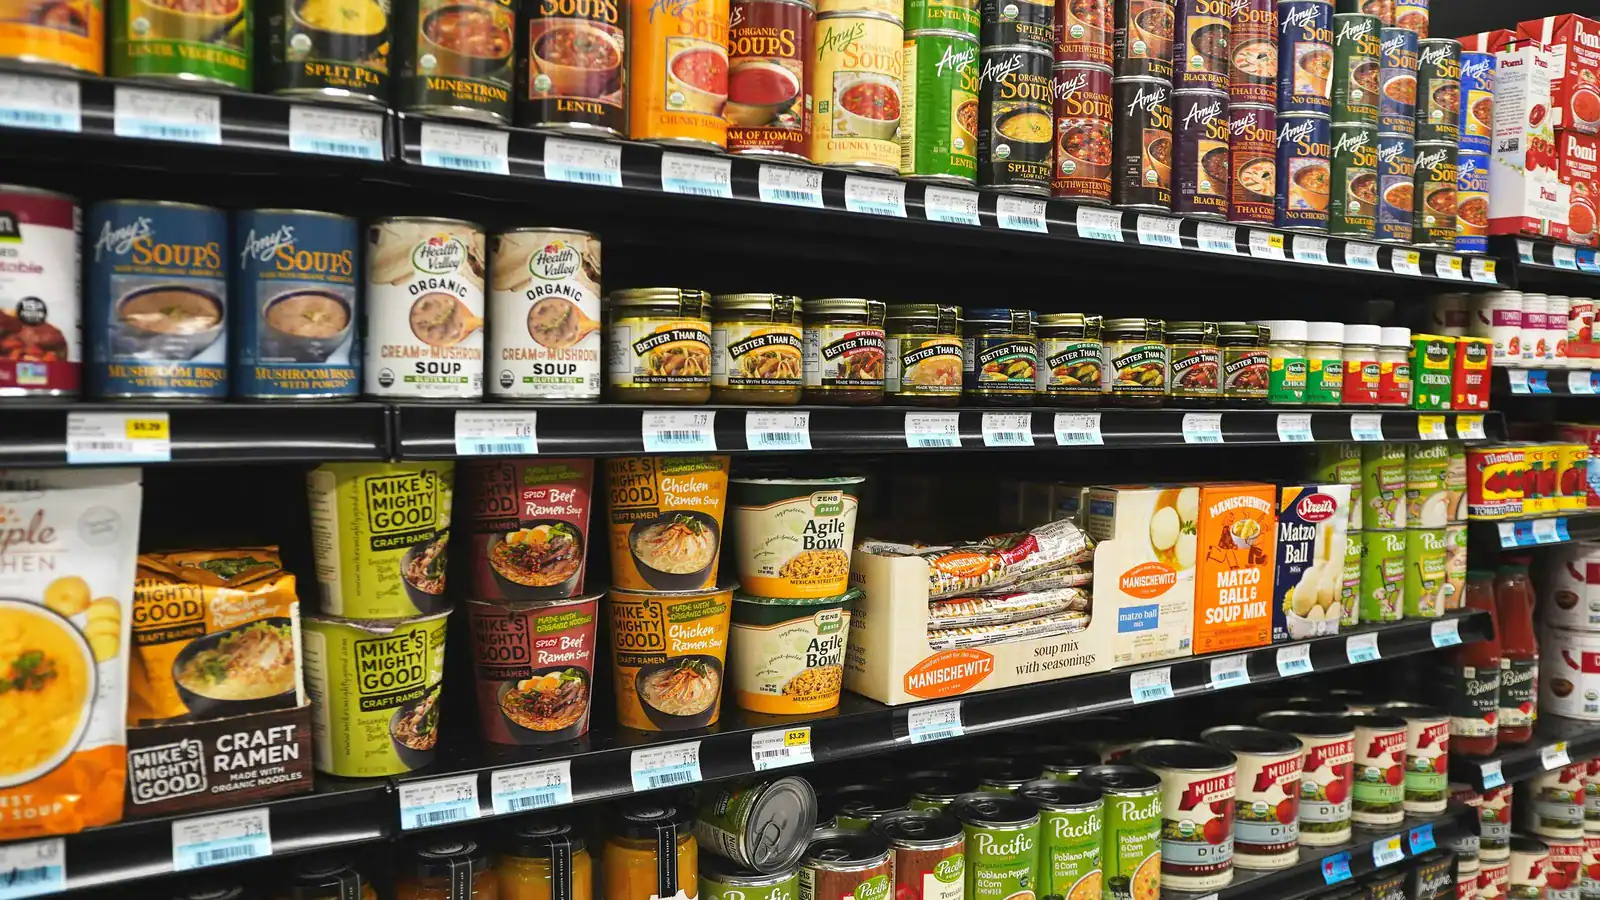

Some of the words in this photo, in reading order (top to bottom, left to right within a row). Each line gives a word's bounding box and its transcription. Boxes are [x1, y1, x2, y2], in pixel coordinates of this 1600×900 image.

[738, 28, 778, 37] ORGANIC
[1016, 23, 1042, 38] SPLIT
[935, 45, 976, 78] Amy's
[1418, 44, 1452, 69] Amy's
[1500, 59, 1524, 70] Pomi
[1534, 56, 1549, 68] Pomi
[305, 63, 350, 80] SPLIT
[355, 67, 380, 86] PEA
[979, 53, 1024, 90] Amy's
[1460, 58, 1490, 80] Amy's
[557, 100, 605, 116] LENTIL
[1127, 87, 1166, 116] Amy's
[1292, 96, 1304, 104] NO
[1184, 100, 1222, 130] Amy's
[747, 131, 760, 140] OF
[762, 131, 803, 143] TOMATO
[1568, 134, 1598, 162] Pomi
[1415, 148, 1448, 170] Amy's
[1008, 163, 1036, 174] SPLIT
[806, 177, 819, 188] 5.19
[1540, 186, 1558, 202] Pomi
[1033, 204, 1043, 214] 5.19
[1236, 204, 1258, 214] THAI
[1286, 211, 1298, 219] NO
[94, 216, 155, 262] Amy's
[240, 224, 298, 270] Amy's
[132, 236, 221, 268] SOUPS
[276, 245, 352, 275] SOUPS
[536, 250, 573, 265] Health
[544, 262, 576, 276] Valley
[408, 278, 468, 298] ORGANIC
[526, 284, 583, 302] ORGANIC
[636, 334, 670, 354] BETTER
[672, 331, 696, 341] THAN
[732, 338, 765, 356] BETTER
[766, 334, 788, 344] THAN
[824, 340, 858, 358] BETTER
[858, 337, 877, 348] THAN
[381, 345, 419, 359] CREAM
[502, 348, 537, 360] CREAM
[904, 350, 934, 365] BETTER
[936, 346, 954, 356] THAN
[980, 348, 1010, 364] BETTER
[1010, 345, 1028, 356] THAN
[1050, 352, 1078, 367] BETTER
[1080, 350, 1096, 358] THAN
[1116, 354, 1144, 368] BETTER
[1144, 351, 1160, 360] THAN
[416, 362, 462, 374] SOUP
[533, 364, 578, 376] SOUP
[1174, 356, 1200, 370] BETTER
[1201, 354, 1215, 362] THAN
[1226, 358, 1252, 372] BETTER
[1252, 356, 1266, 364] THAN
[1420, 374, 1451, 384] CHICKEN
[1466, 375, 1482, 384] BEEF
[133, 422, 160, 431] $5.29
[694, 414, 708, 425] 7.79
[794, 417, 806, 427] 7.79
[371, 469, 434, 496] MIKE'S
[660, 478, 709, 494] Chicken
[373, 492, 434, 511] MIGHTY
[523, 490, 546, 500] SPICY
[549, 488, 575, 503] Beef
[612, 486, 654, 504] GOOD
[664, 493, 702, 506] Ramen
[703, 496, 720, 508] Soup
[526, 502, 566, 516] Ramen
[566, 506, 582, 518] Soup
[820, 505, 840, 513] pasta
[1208, 496, 1272, 519] MANISCHEWITZ
[1474, 506, 1506, 516] TOMATO
[375, 507, 434, 528] GOOD
[632, 512, 658, 520] RAMEN
[803, 517, 846, 534] Agile
[1280, 523, 1316, 542] Matzo
[373, 537, 406, 548] CRAFT
[406, 532, 436, 544] RAMEN
[803, 532, 844, 550] Bowl
[1284, 543, 1308, 564] Ball
[1217, 568, 1260, 588] MATZO
[1289, 566, 1301, 574] Mix
[790, 578, 816, 586] MEXICAN
[816, 576, 834, 584] STREET
[1122, 573, 1176, 588] MANISCHEWITZ
[1219, 588, 1249, 605] BALL
[133, 602, 200, 623] GOOD
[614, 604, 659, 620] MIKE'S
[672, 604, 693, 612] MADE
[693, 601, 710, 610] WITH
[1204, 606, 1242, 624] SOUP
[1242, 602, 1266, 619] MIX
[538, 615, 558, 625] MADE
[558, 612, 577, 622] WITH
[1120, 612, 1142, 622] matzo
[1144, 608, 1158, 620] ball
[537, 620, 568, 632] ORGANIC
[614, 620, 660, 634] MIGHTY
[668, 624, 714, 640] Chicken
[1133, 620, 1144, 628] mix
[360, 634, 424, 658] MIKE'S
[535, 638, 558, 648] SPICY
[560, 634, 586, 650] Beef
[616, 633, 661, 648] GOOD
[672, 640, 708, 652] Ramen
[806, 635, 843, 654] Agile
[538, 650, 575, 664] Ramen
[575, 649, 590, 661] Soup
[1033, 644, 1059, 658] soup
[1060, 640, 1080, 654] mix
[362, 650, 424, 672] MIGHTY
[636, 655, 665, 664] RAMEN
[806, 650, 842, 668] Bowl
[1015, 662, 1040, 676] with
[1042, 652, 1096, 672] seasonings
[364, 666, 424, 690] GOOD
[908, 658, 990, 690] MANISCHEWITZ
[362, 698, 394, 709] CRAFT
[394, 690, 425, 704] RAMEN
[792, 694, 817, 702] MEXICAN
[216, 724, 298, 752] CRAFT
[789, 731, 804, 740] $3.29
[134, 744, 198, 768] MIKE'S
[214, 743, 300, 772] RAMEN
[683, 754, 696, 764] 2.79
[1318, 747, 1345, 760] MUIR
[136, 760, 198, 782] MIGHTY
[230, 770, 258, 781] MADE
[260, 766, 286, 776] WITH
[1268, 764, 1296, 780] MUIR
[138, 776, 200, 800] GOOD
[211, 781, 256, 793] ORGANIC
[258, 772, 303, 786] NOODLES
[546, 777, 561, 787] 2.79
[1195, 781, 1226, 796] MUIR
[456, 790, 472, 800] 2.79
[12, 804, 63, 820] SOUP
[1116, 800, 1162, 822] Pacific
[1050, 814, 1102, 838] Pacific
[974, 833, 1033, 856] Pacific
[1120, 835, 1148, 844] Poblano
[1126, 844, 1144, 852] Corn
[1054, 853, 1082, 863] Poblano
[1060, 862, 1078, 870] Corn
[978, 870, 1008, 880] Poblano
[1008, 867, 1030, 880] Pepper
[983, 880, 1002, 888] Corn
